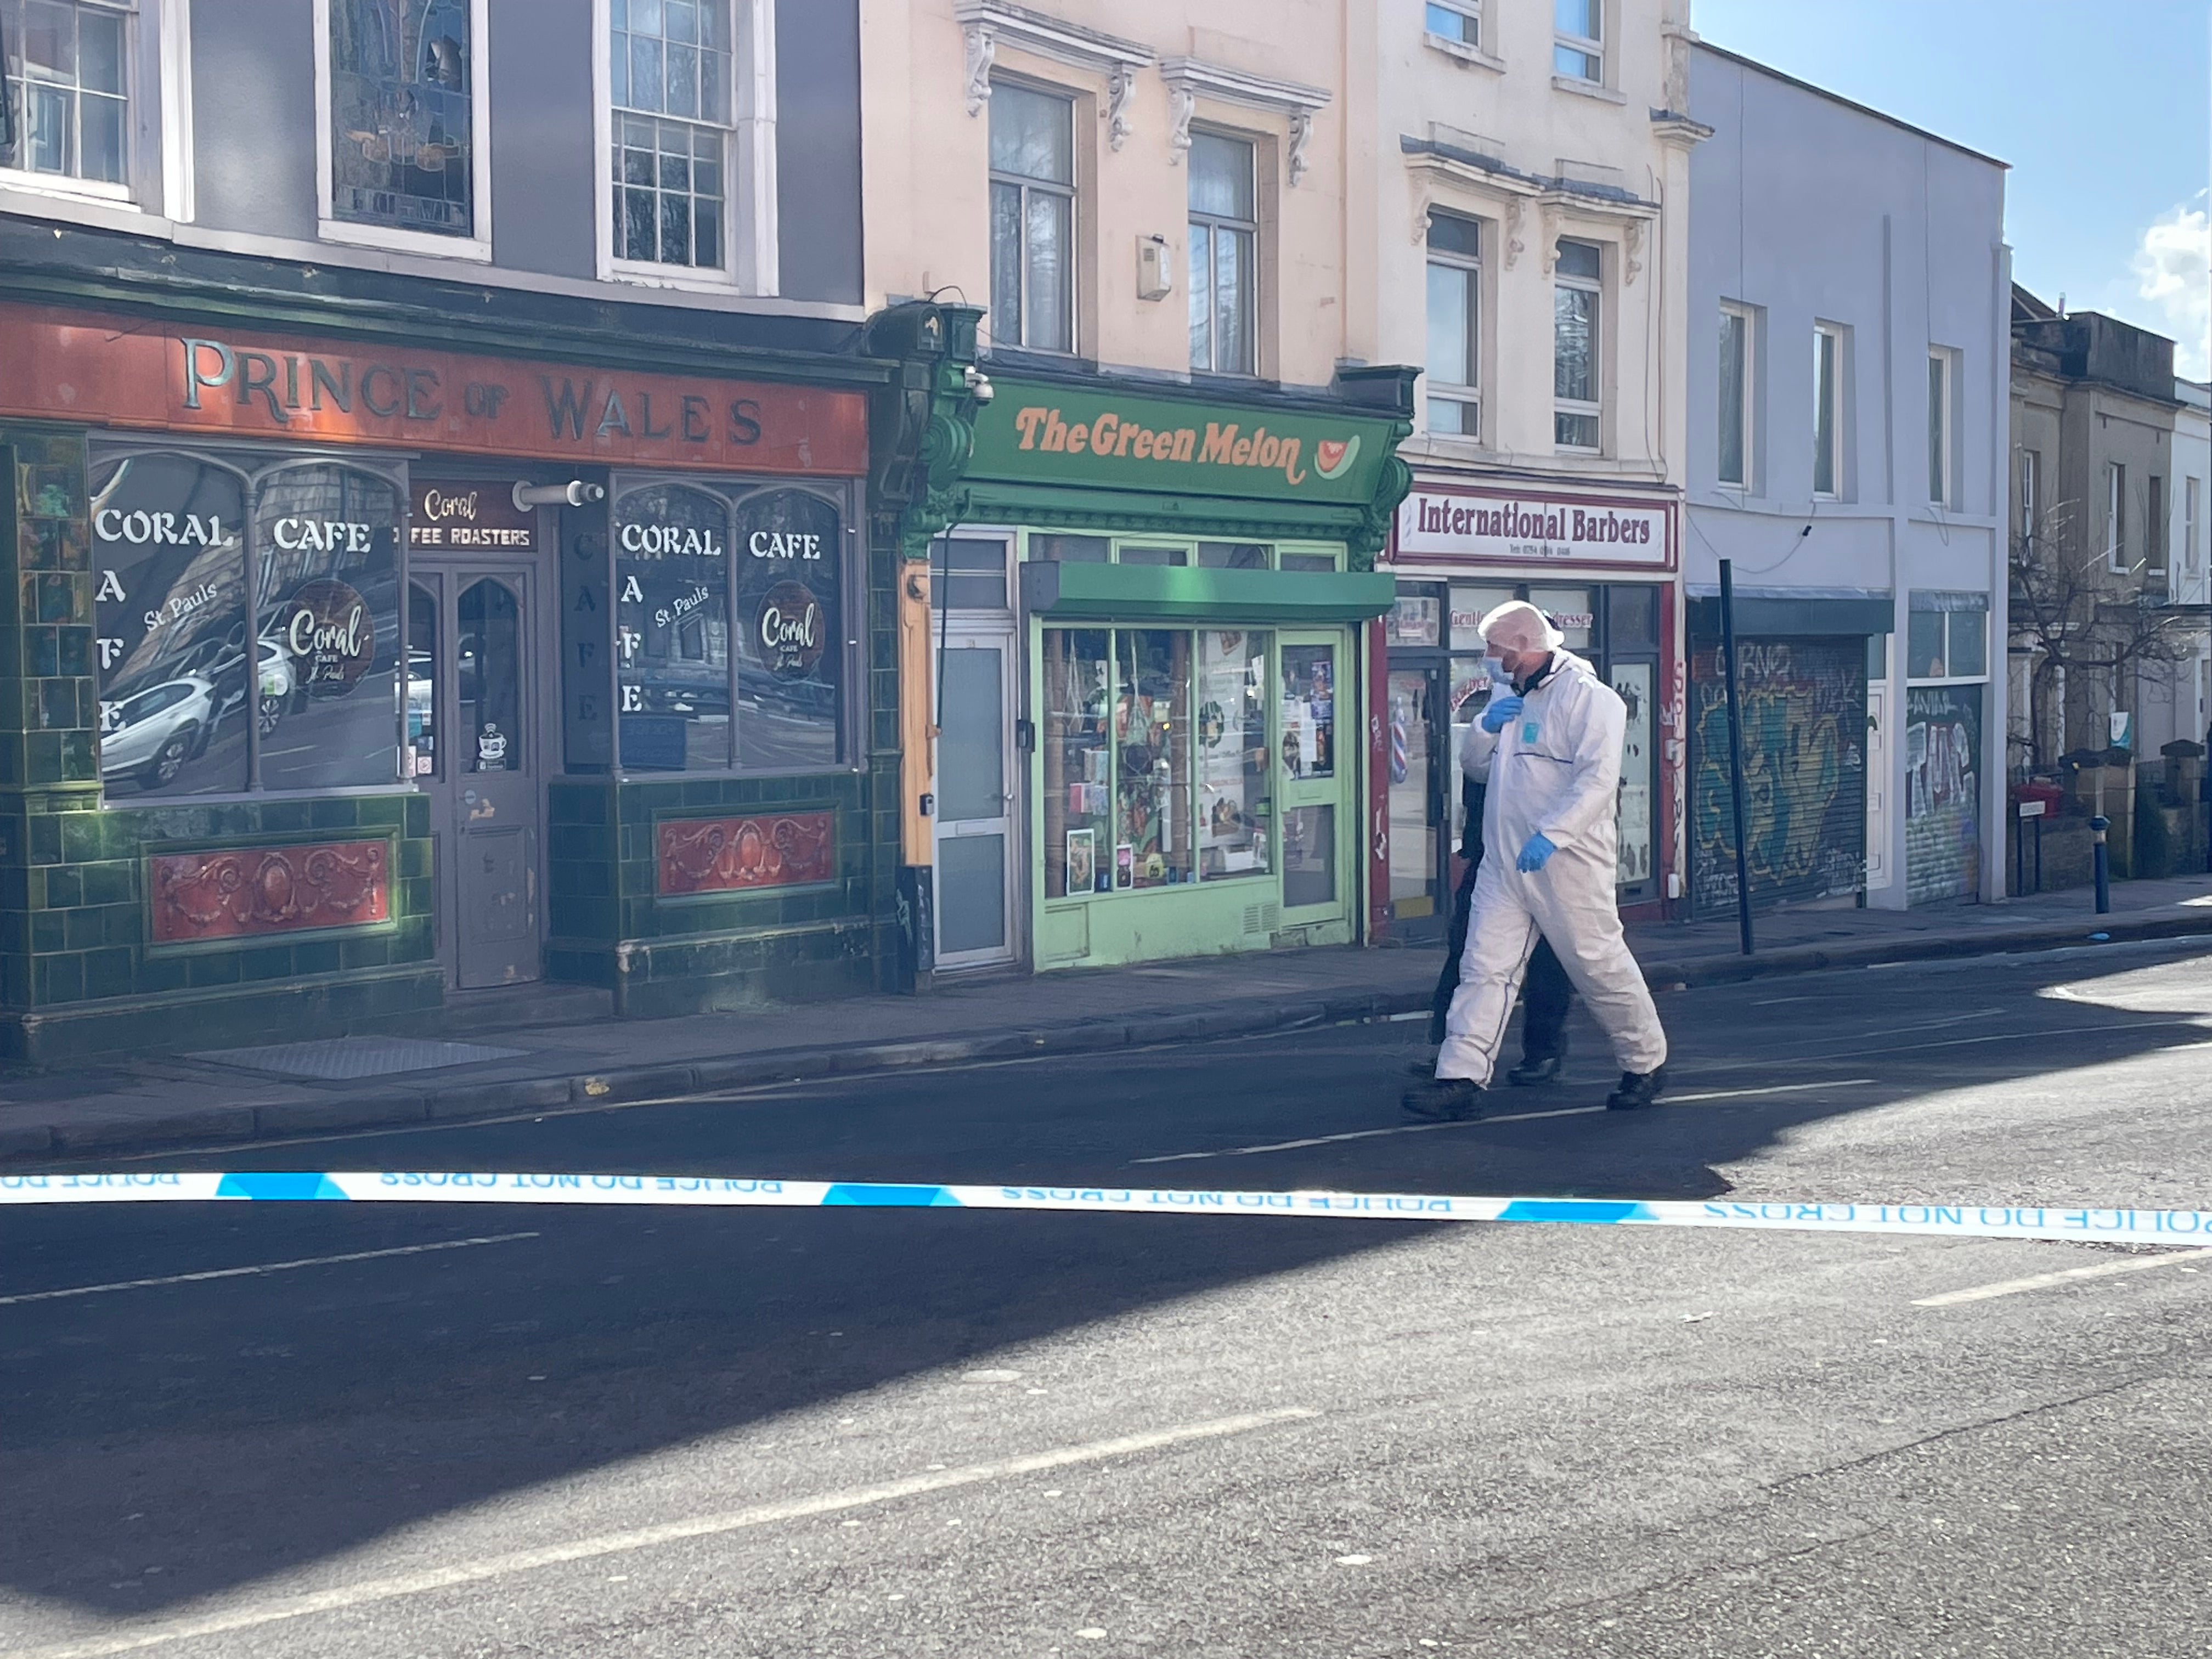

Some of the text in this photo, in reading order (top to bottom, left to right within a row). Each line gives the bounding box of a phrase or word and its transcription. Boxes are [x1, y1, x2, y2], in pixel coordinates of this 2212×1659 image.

[180, 337, 763, 445] PRINCE OF WALES
[1016, 407, 1306, 485] The Green Melon
[424, 489, 477, 521] Coral
[1418, 498, 1650, 544] International Barbers
[95, 508, 371, 553] CORAL CAFE
[451, 528, 529, 545] ROASTERS
[621, 524, 820, 560] CORAL CAFE
[290, 605, 362, 657] Coral
[762, 602, 815, 647] Coral
[315, 654, 338, 663] CAFE
